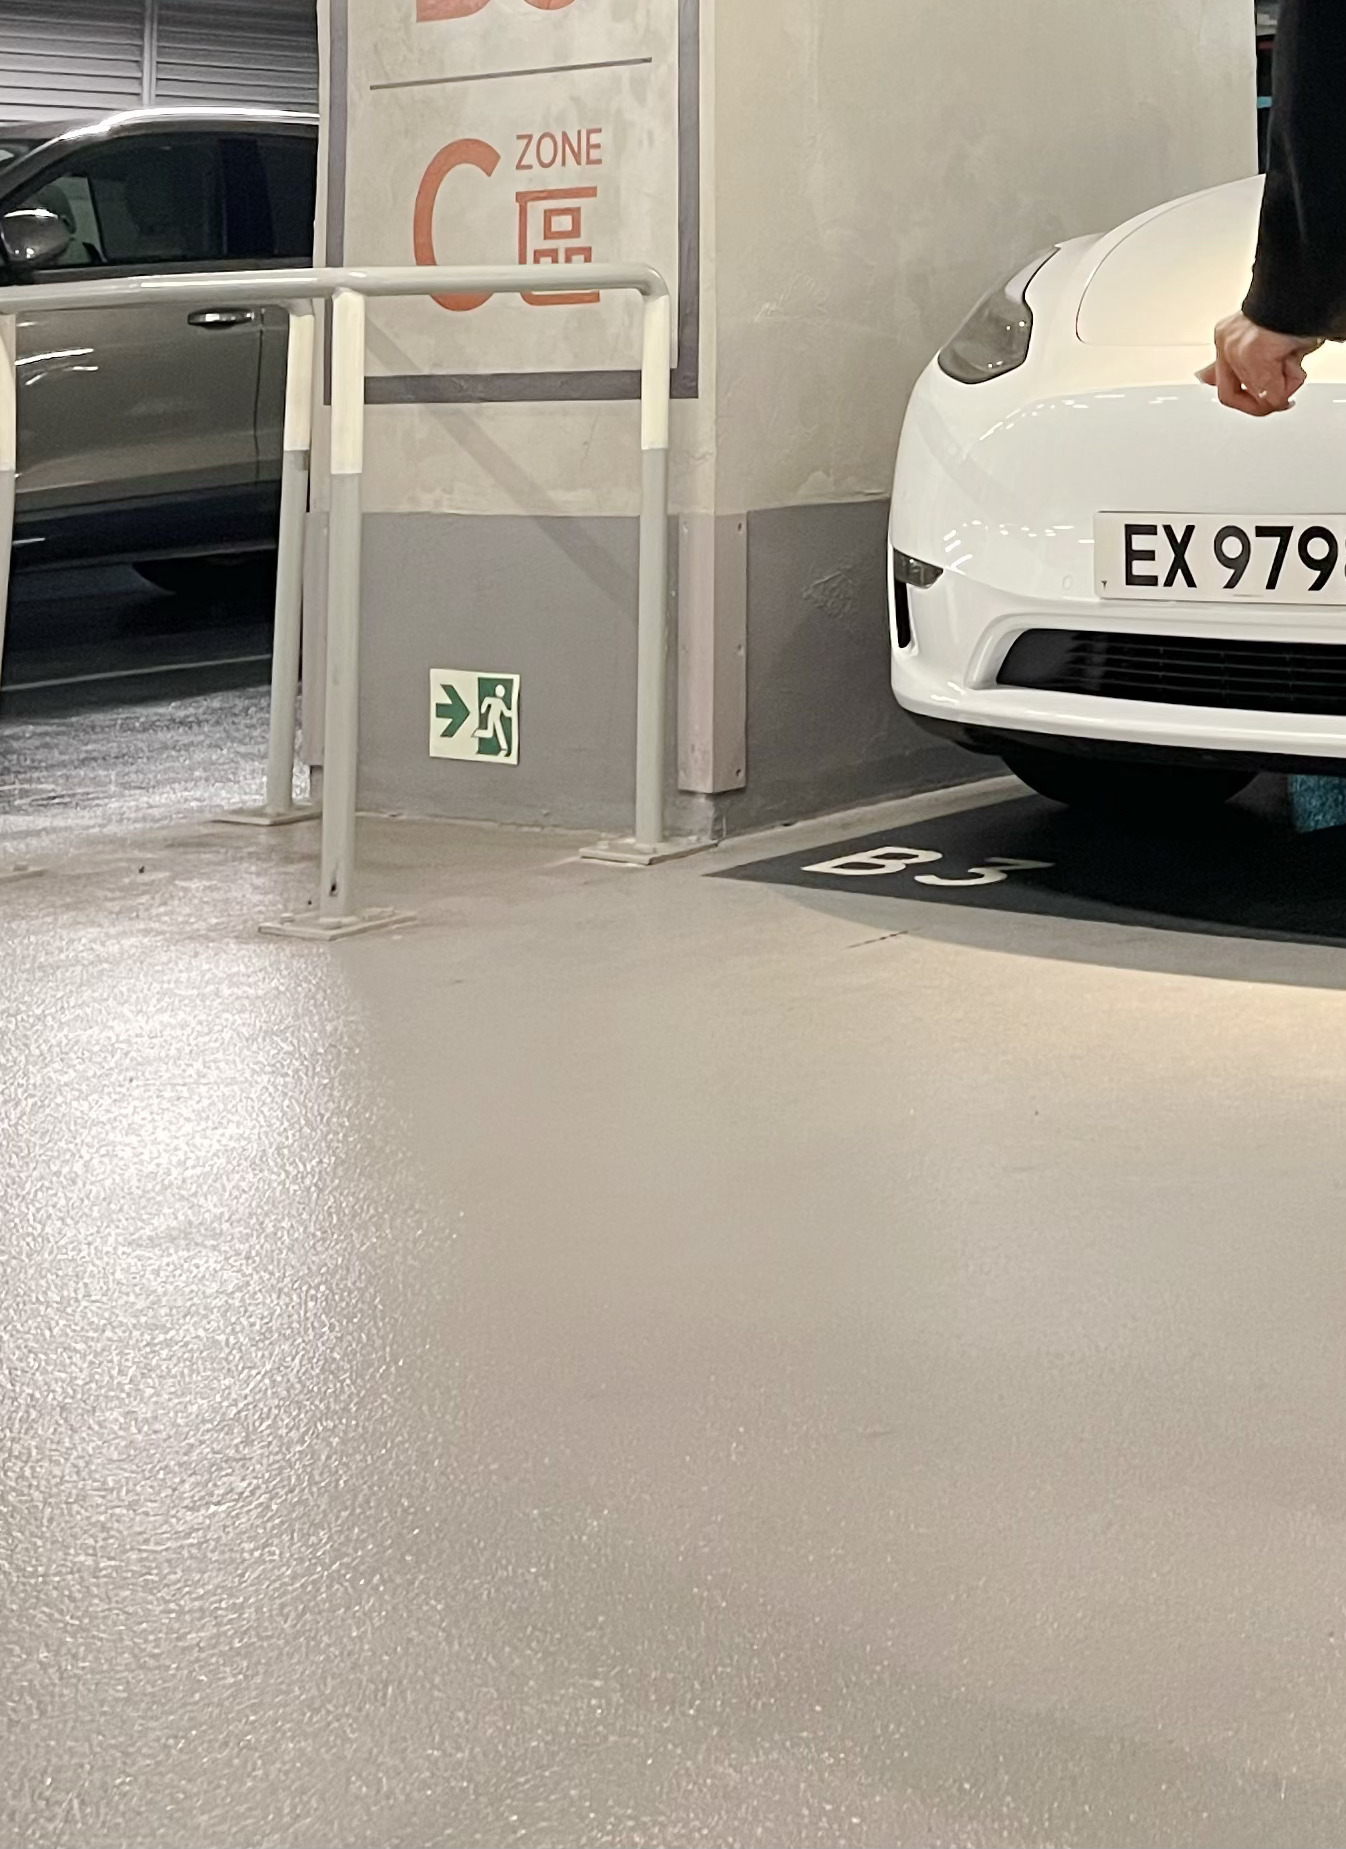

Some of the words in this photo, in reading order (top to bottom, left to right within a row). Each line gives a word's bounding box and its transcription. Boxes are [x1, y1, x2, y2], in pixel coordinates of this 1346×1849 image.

[514, 127, 603, 171] ZONE
[412, 137, 501, 312] C
[1123, 523, 1198, 589] EX
[800, 845, 1055, 887] B3
